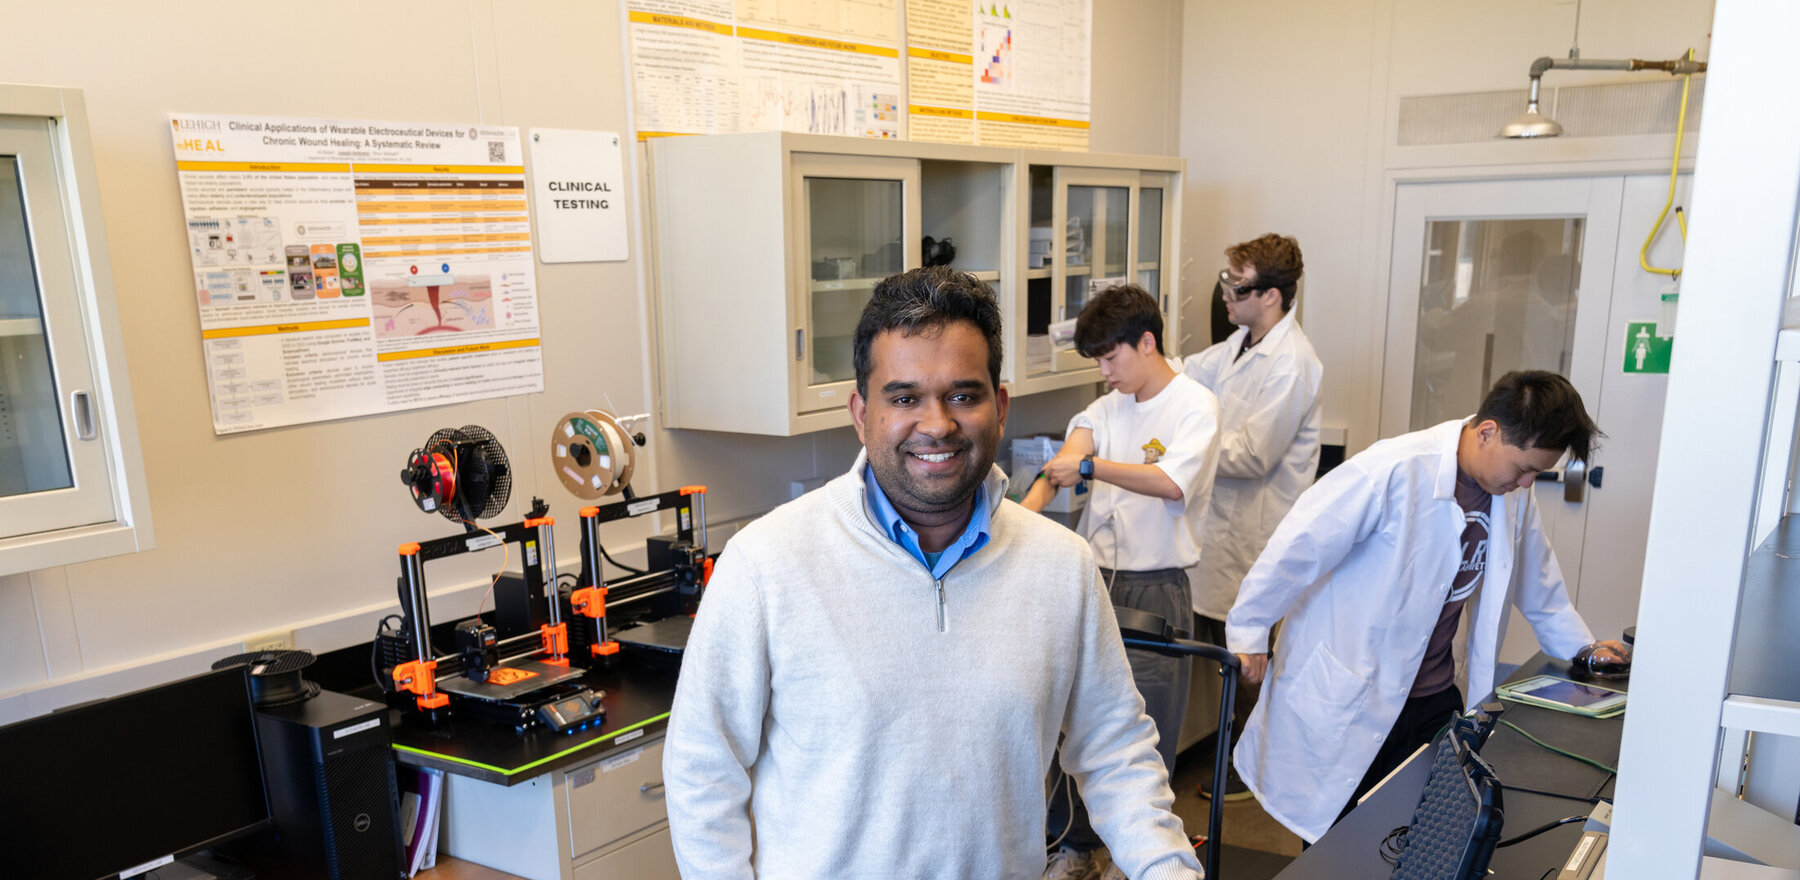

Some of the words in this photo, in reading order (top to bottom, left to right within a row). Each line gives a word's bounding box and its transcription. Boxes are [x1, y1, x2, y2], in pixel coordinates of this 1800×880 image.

[180, 119, 221, 129] LEHIGH
[229, 121, 262, 131] Clinical
[264, 123, 317, 134] Applications
[319, 124, 328, 133] of
[330, 125, 367, 135] Wearable
[368, 126, 424, 137] Electroceutical
[425, 128, 453, 138] Devices
[455, 129, 465, 138] for
[263, 136, 297, 146] Chronic
[299, 137, 328, 147] Wound
[330, 139, 361, 150] Healing:
[364, 139, 370, 147] A
[372, 139, 413, 149] Systematic
[415, 140, 442, 149] Review
[549, 182, 611, 192] CLINICAL
[553, 200, 609, 209] TESTING
